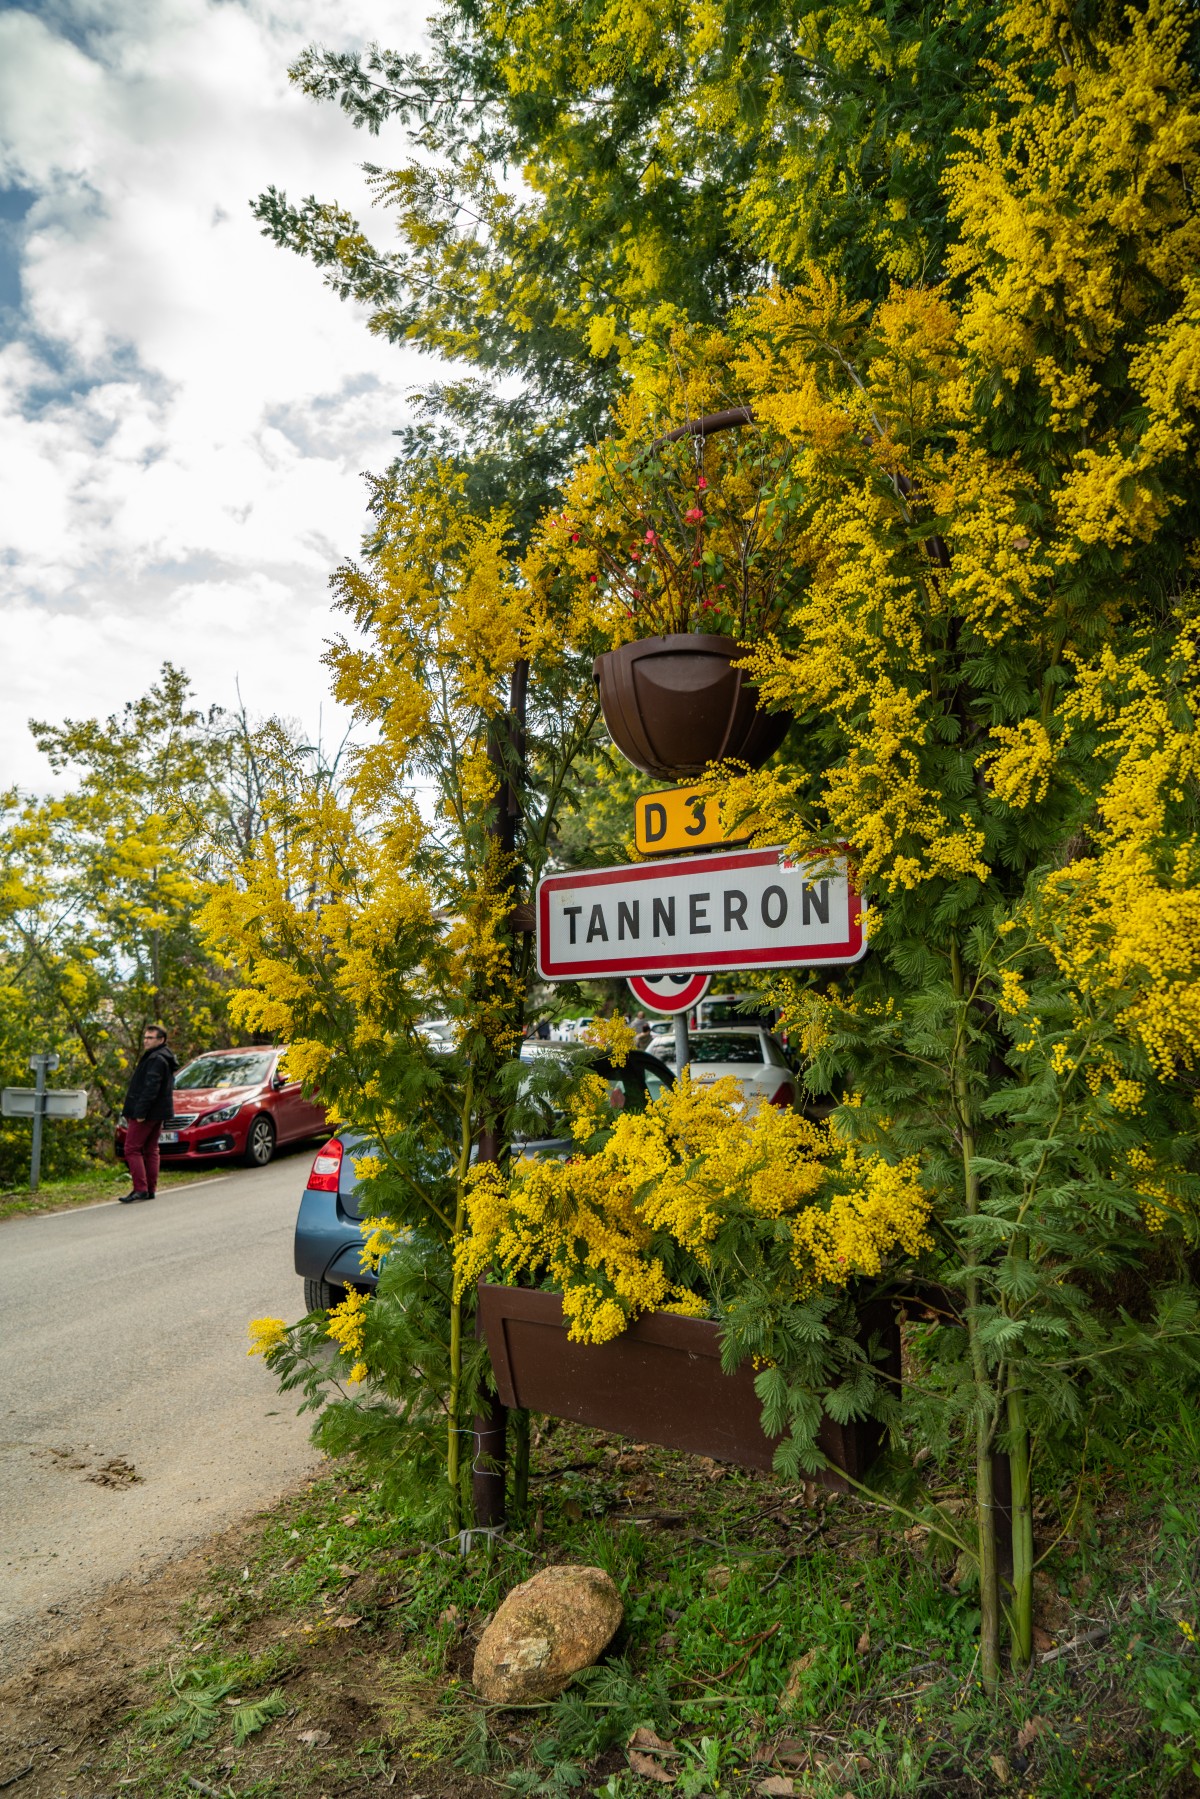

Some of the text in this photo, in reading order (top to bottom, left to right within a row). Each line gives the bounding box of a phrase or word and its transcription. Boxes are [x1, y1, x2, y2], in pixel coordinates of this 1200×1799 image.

[644, 795, 729, 844] D 3
[563, 880, 830, 945] TANNERON
